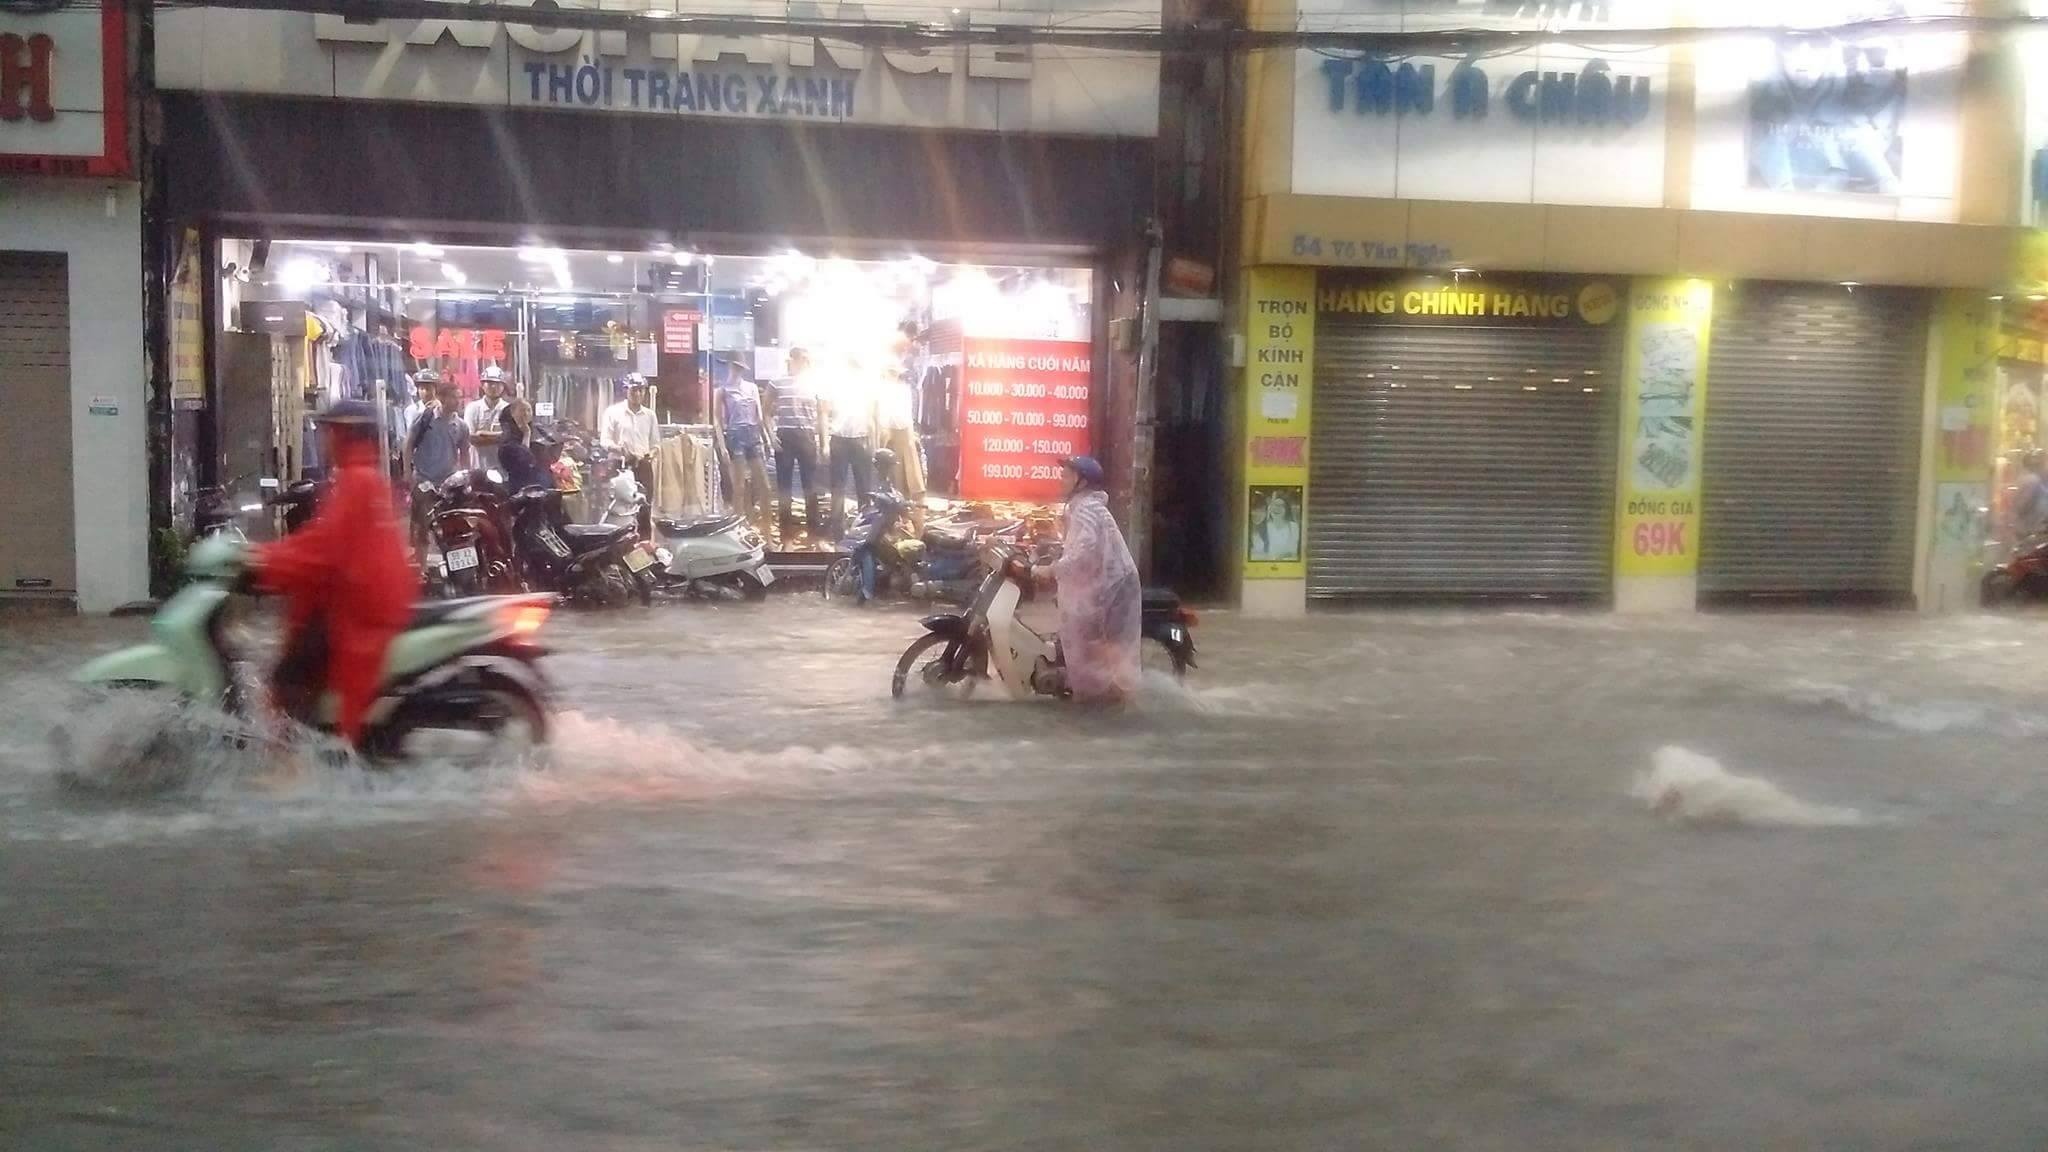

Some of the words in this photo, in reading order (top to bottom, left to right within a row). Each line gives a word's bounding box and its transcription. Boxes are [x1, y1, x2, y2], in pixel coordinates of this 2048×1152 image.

[524, 54, 613, 105] THỜI
[624, 68, 748, 113] TRANG
[756, 75, 854, 117] XANH
[1402, 285, 1486, 316] CHÍNH
[408, 326, 507, 360] SALE
[1257, 346, 1304, 364] KÍNH
[968, 381, 1003, 397] 10.000
[1010, 382, 1046, 398] 30.000
[1053, 385, 1089, 400] 40.000
[967, 409, 1002, 425] 50.000
[1011, 412, 1045, 427] 70.000
[1053, 413, 1087, 428] 99.000
[982, 437, 1024, 452] 120.000
[1032, 439, 1072, 454] 150.000
[982, 463, 1023, 479] 199.000
[1632, 522, 1687, 557] 69K
